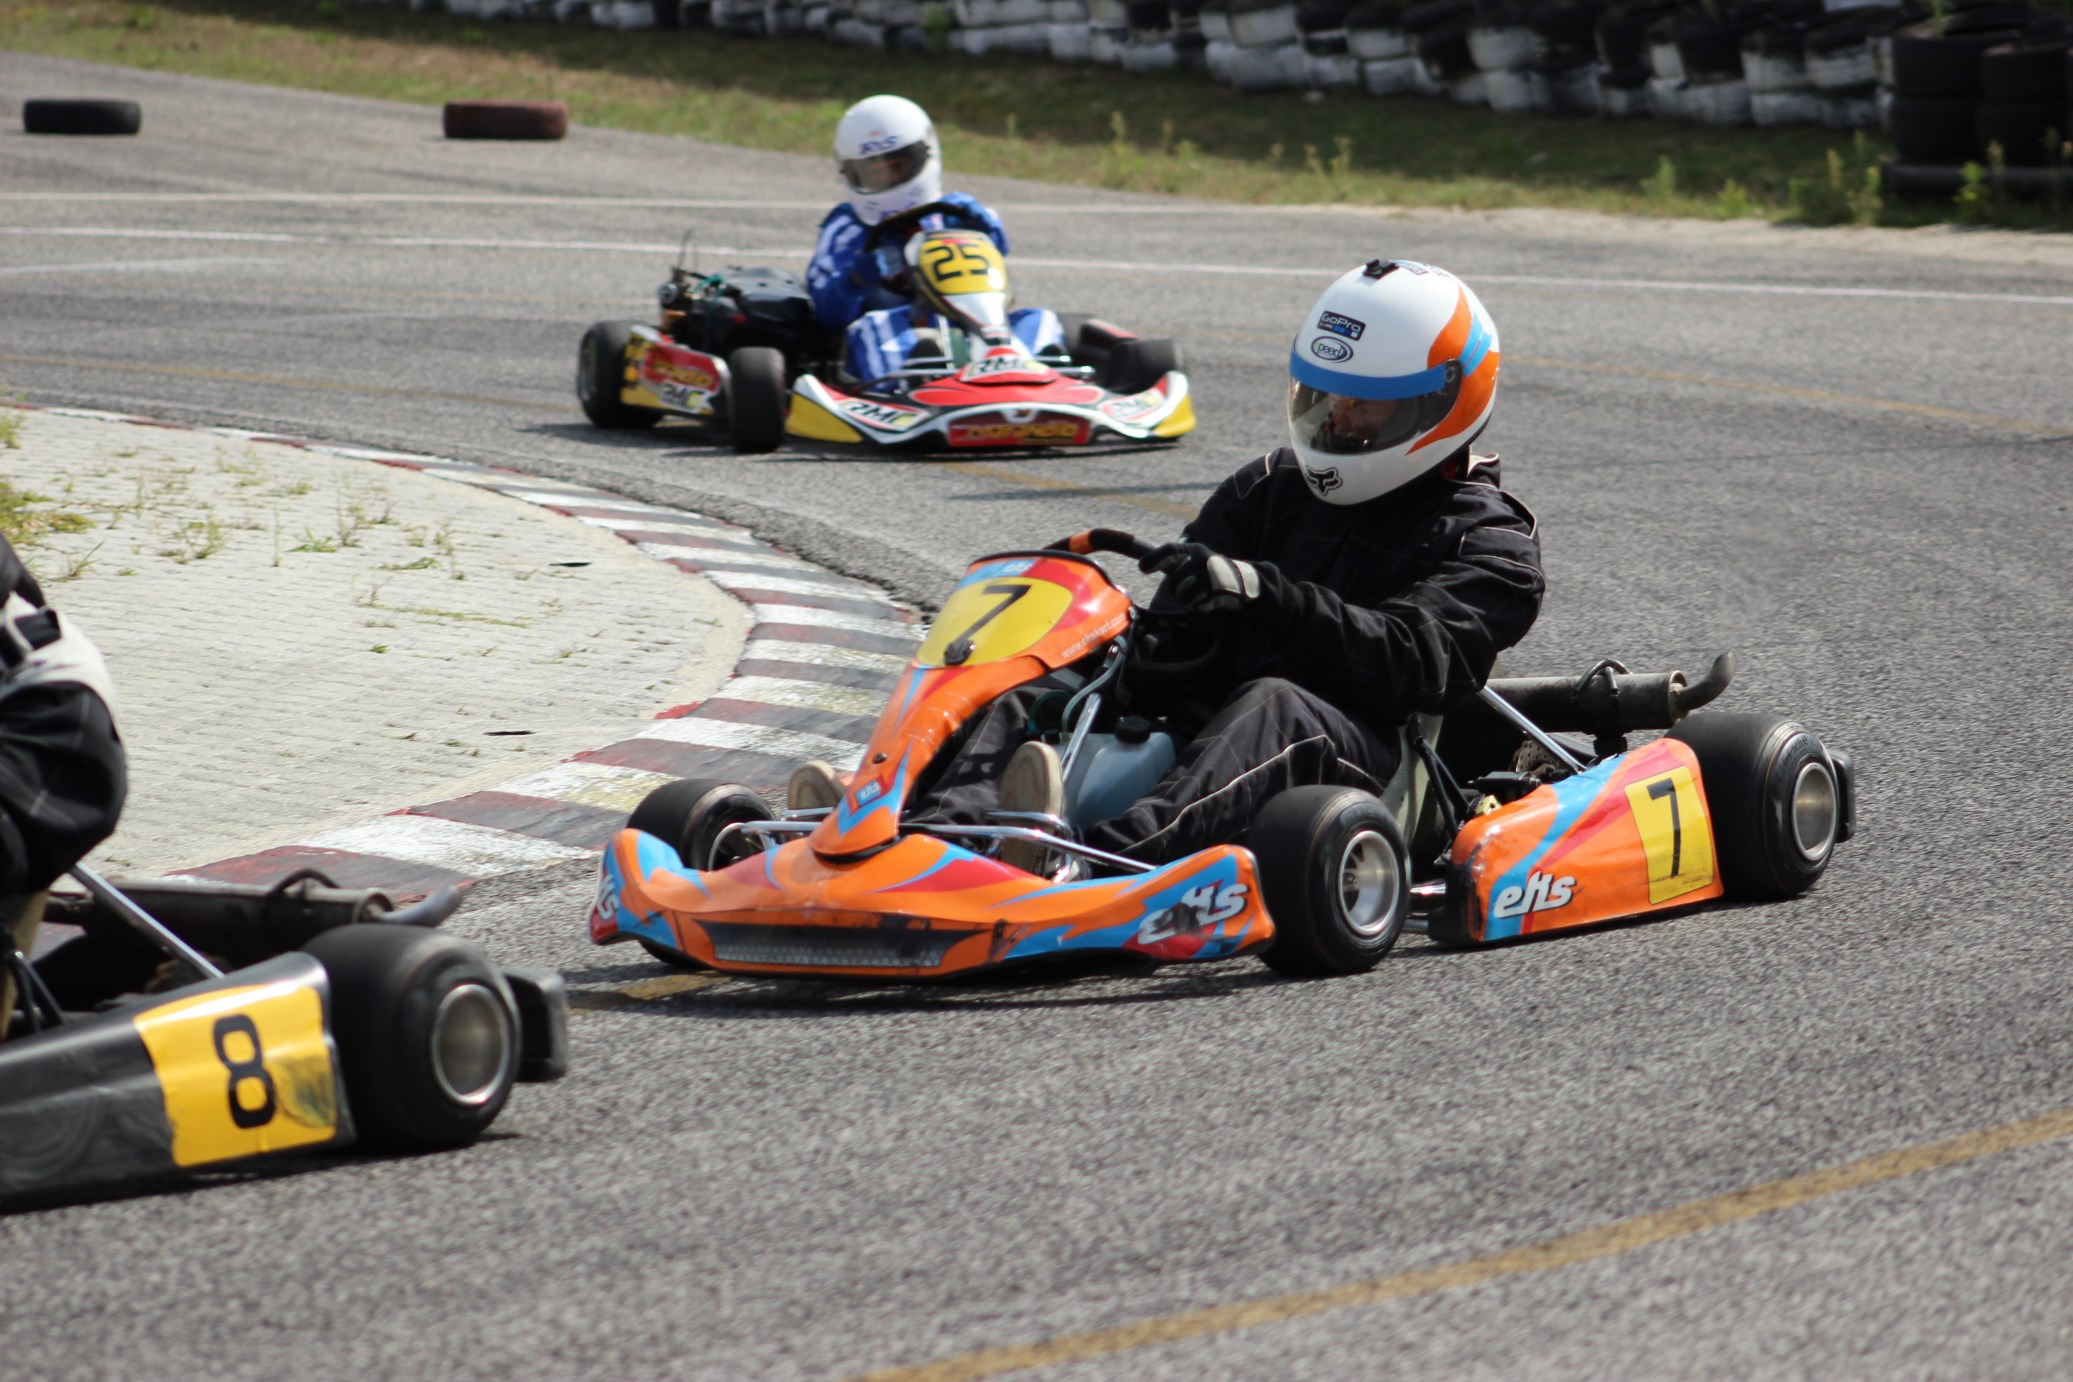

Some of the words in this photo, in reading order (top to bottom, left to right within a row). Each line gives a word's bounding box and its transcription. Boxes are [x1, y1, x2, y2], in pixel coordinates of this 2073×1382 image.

[925, 244, 990, 281] 25
[1321, 313, 1362, 332] GoPro
[950, 585, 1032, 655] 7
[1646, 777, 1682, 878] 7
[213, 1013, 277, 1129] 8
